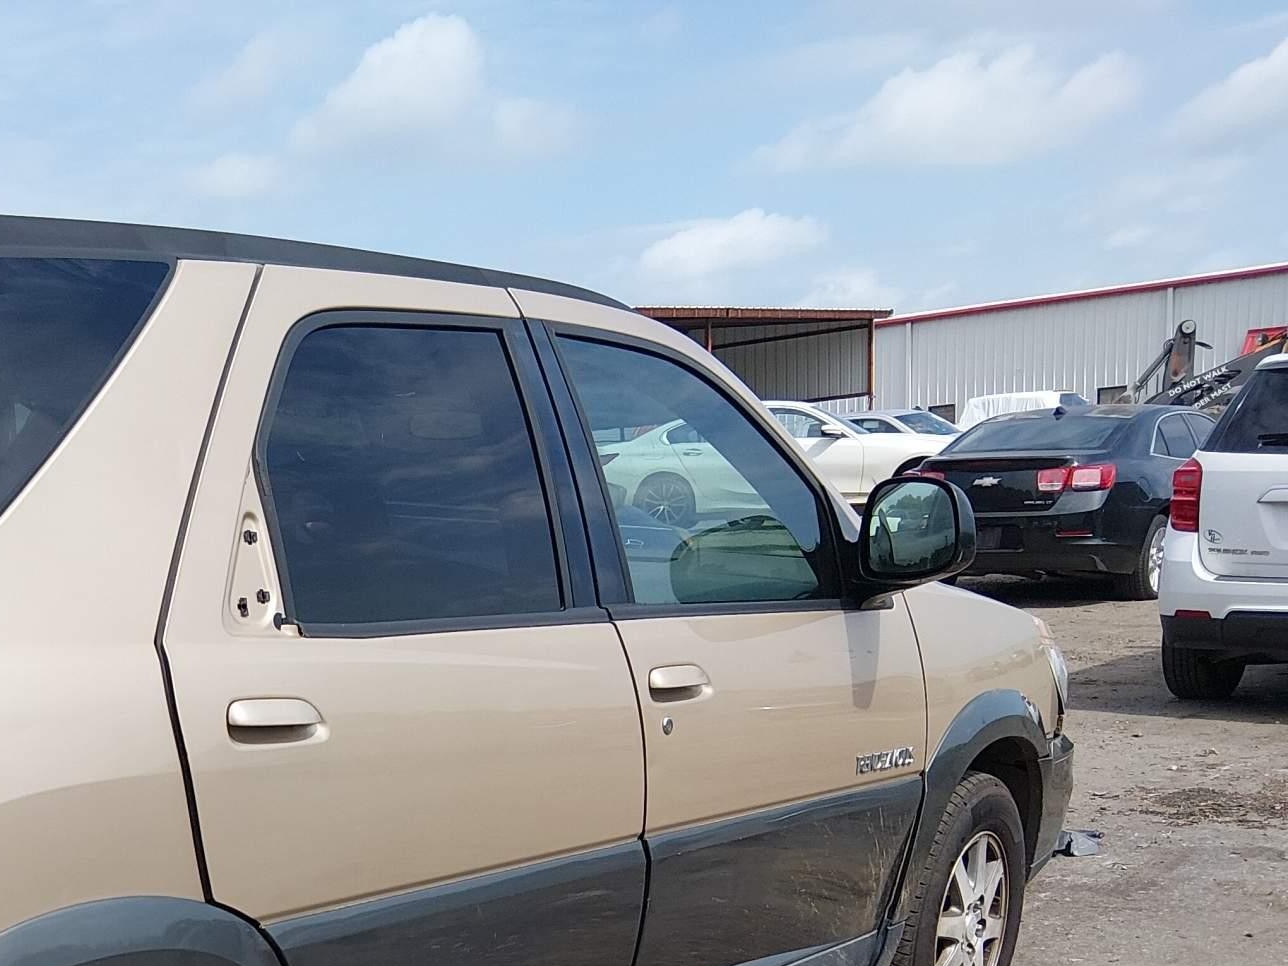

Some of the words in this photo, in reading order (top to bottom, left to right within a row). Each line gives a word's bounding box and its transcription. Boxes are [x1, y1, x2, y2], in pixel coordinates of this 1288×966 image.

[1168, 386, 1182, 397] DO
[1183, 377, 1201, 391] NOT
[1202, 366, 1229, 381] WALK
[1193, 396, 1211, 410] DER
[1210, 382, 1232, 399] MAST
